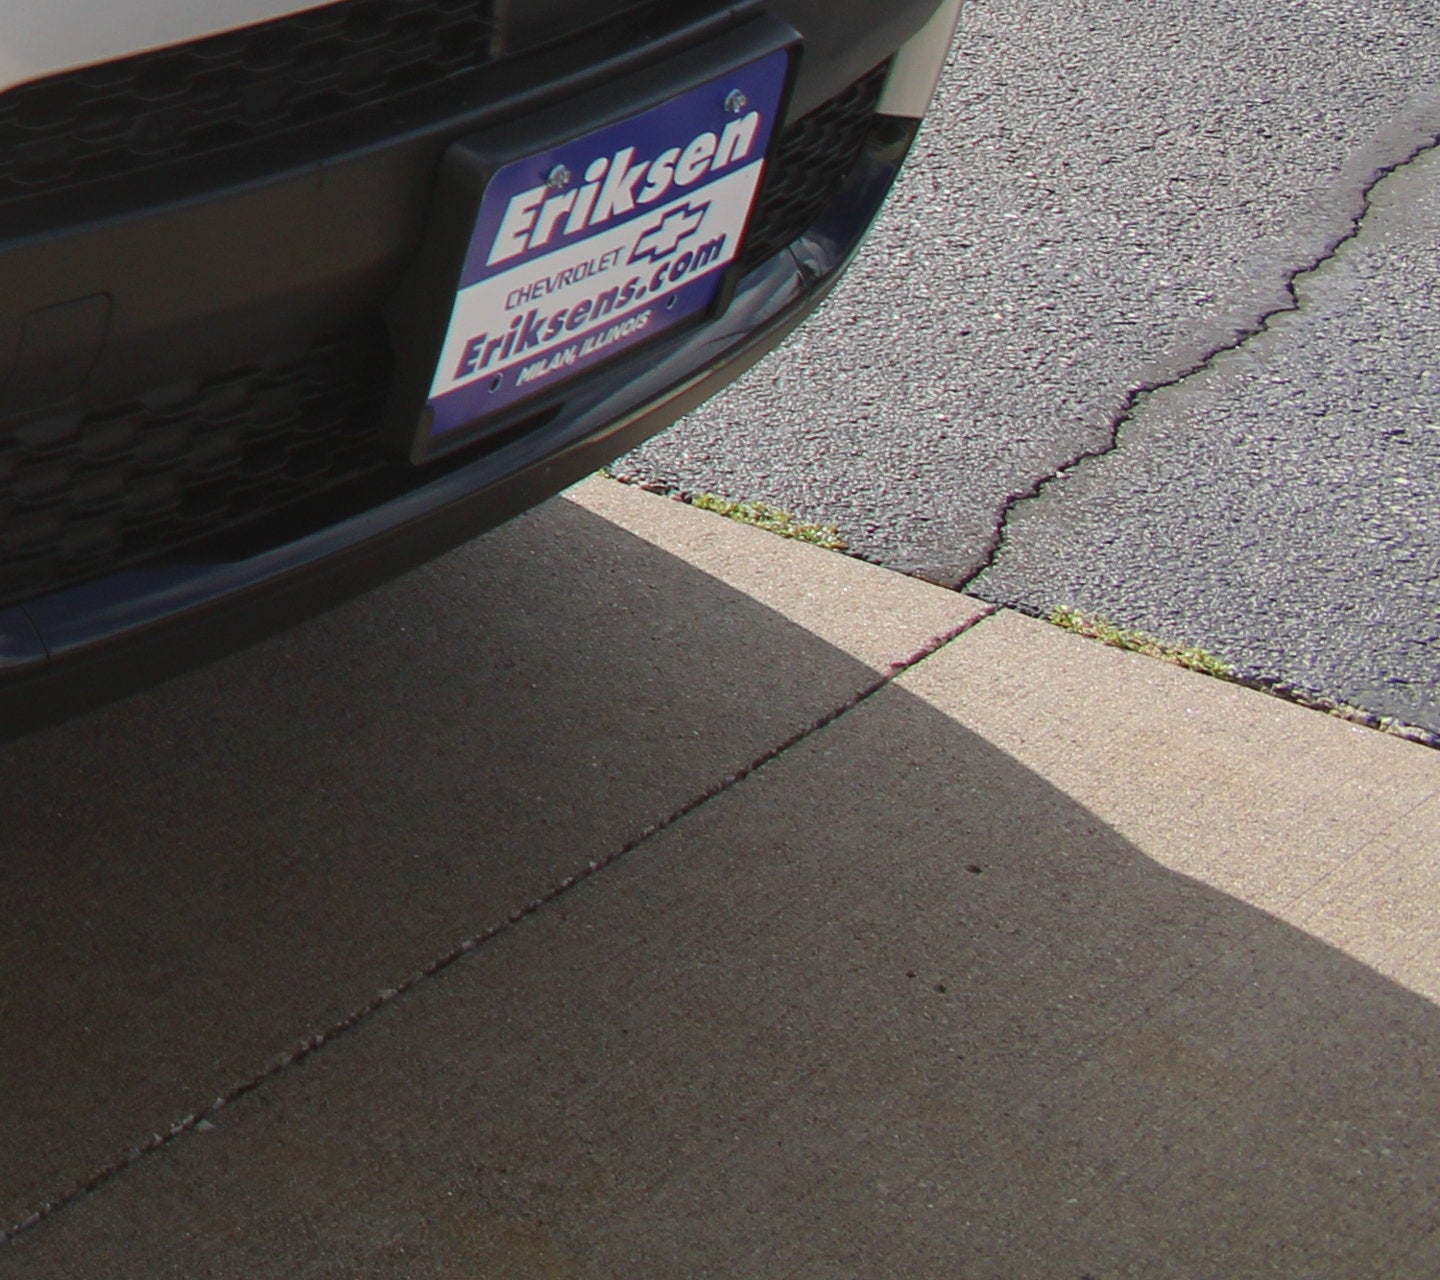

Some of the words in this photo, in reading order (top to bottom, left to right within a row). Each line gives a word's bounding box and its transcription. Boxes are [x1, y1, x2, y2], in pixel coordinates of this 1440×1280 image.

[485, 111, 760, 267] Eriksen
[453, 232, 727, 381] Eriksens.com
[504, 246, 625, 311] CHEVROLET
[516, 346, 576, 386] MILAN,
[579, 309, 653, 359] ILLINOIS
